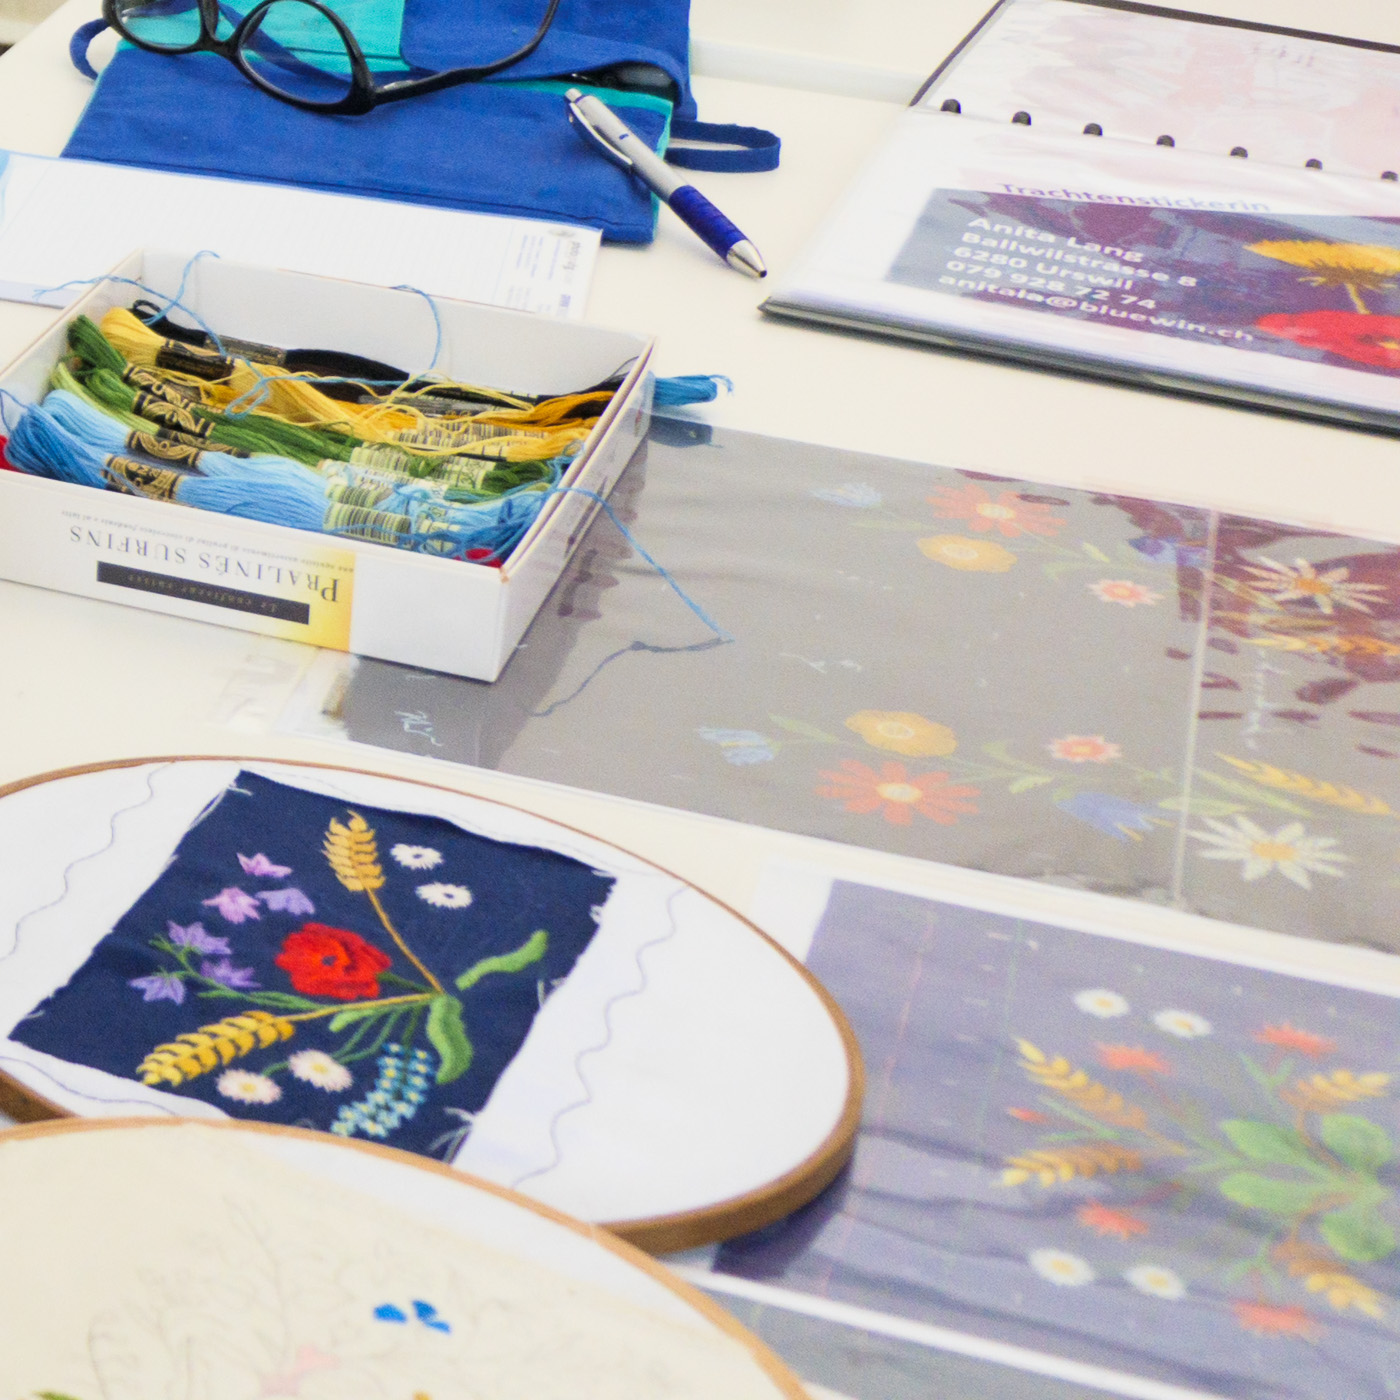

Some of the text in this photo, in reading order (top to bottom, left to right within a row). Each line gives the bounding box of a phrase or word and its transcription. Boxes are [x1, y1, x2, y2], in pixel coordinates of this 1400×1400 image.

[999, 183, 1270, 212] Trachtenstickerin
[961, 232, 1198, 288] Ballwilstrasse 8
[967, 217, 1144, 263] Anita Lang
[946, 260, 1156, 309] 079 928 72 74
[952, 247, 1133, 290] 6280 Urswil
[938, 274, 1254, 341] anitala@bluewin.ch
[69, 525, 340, 603] PRALINÉS SURFINS
